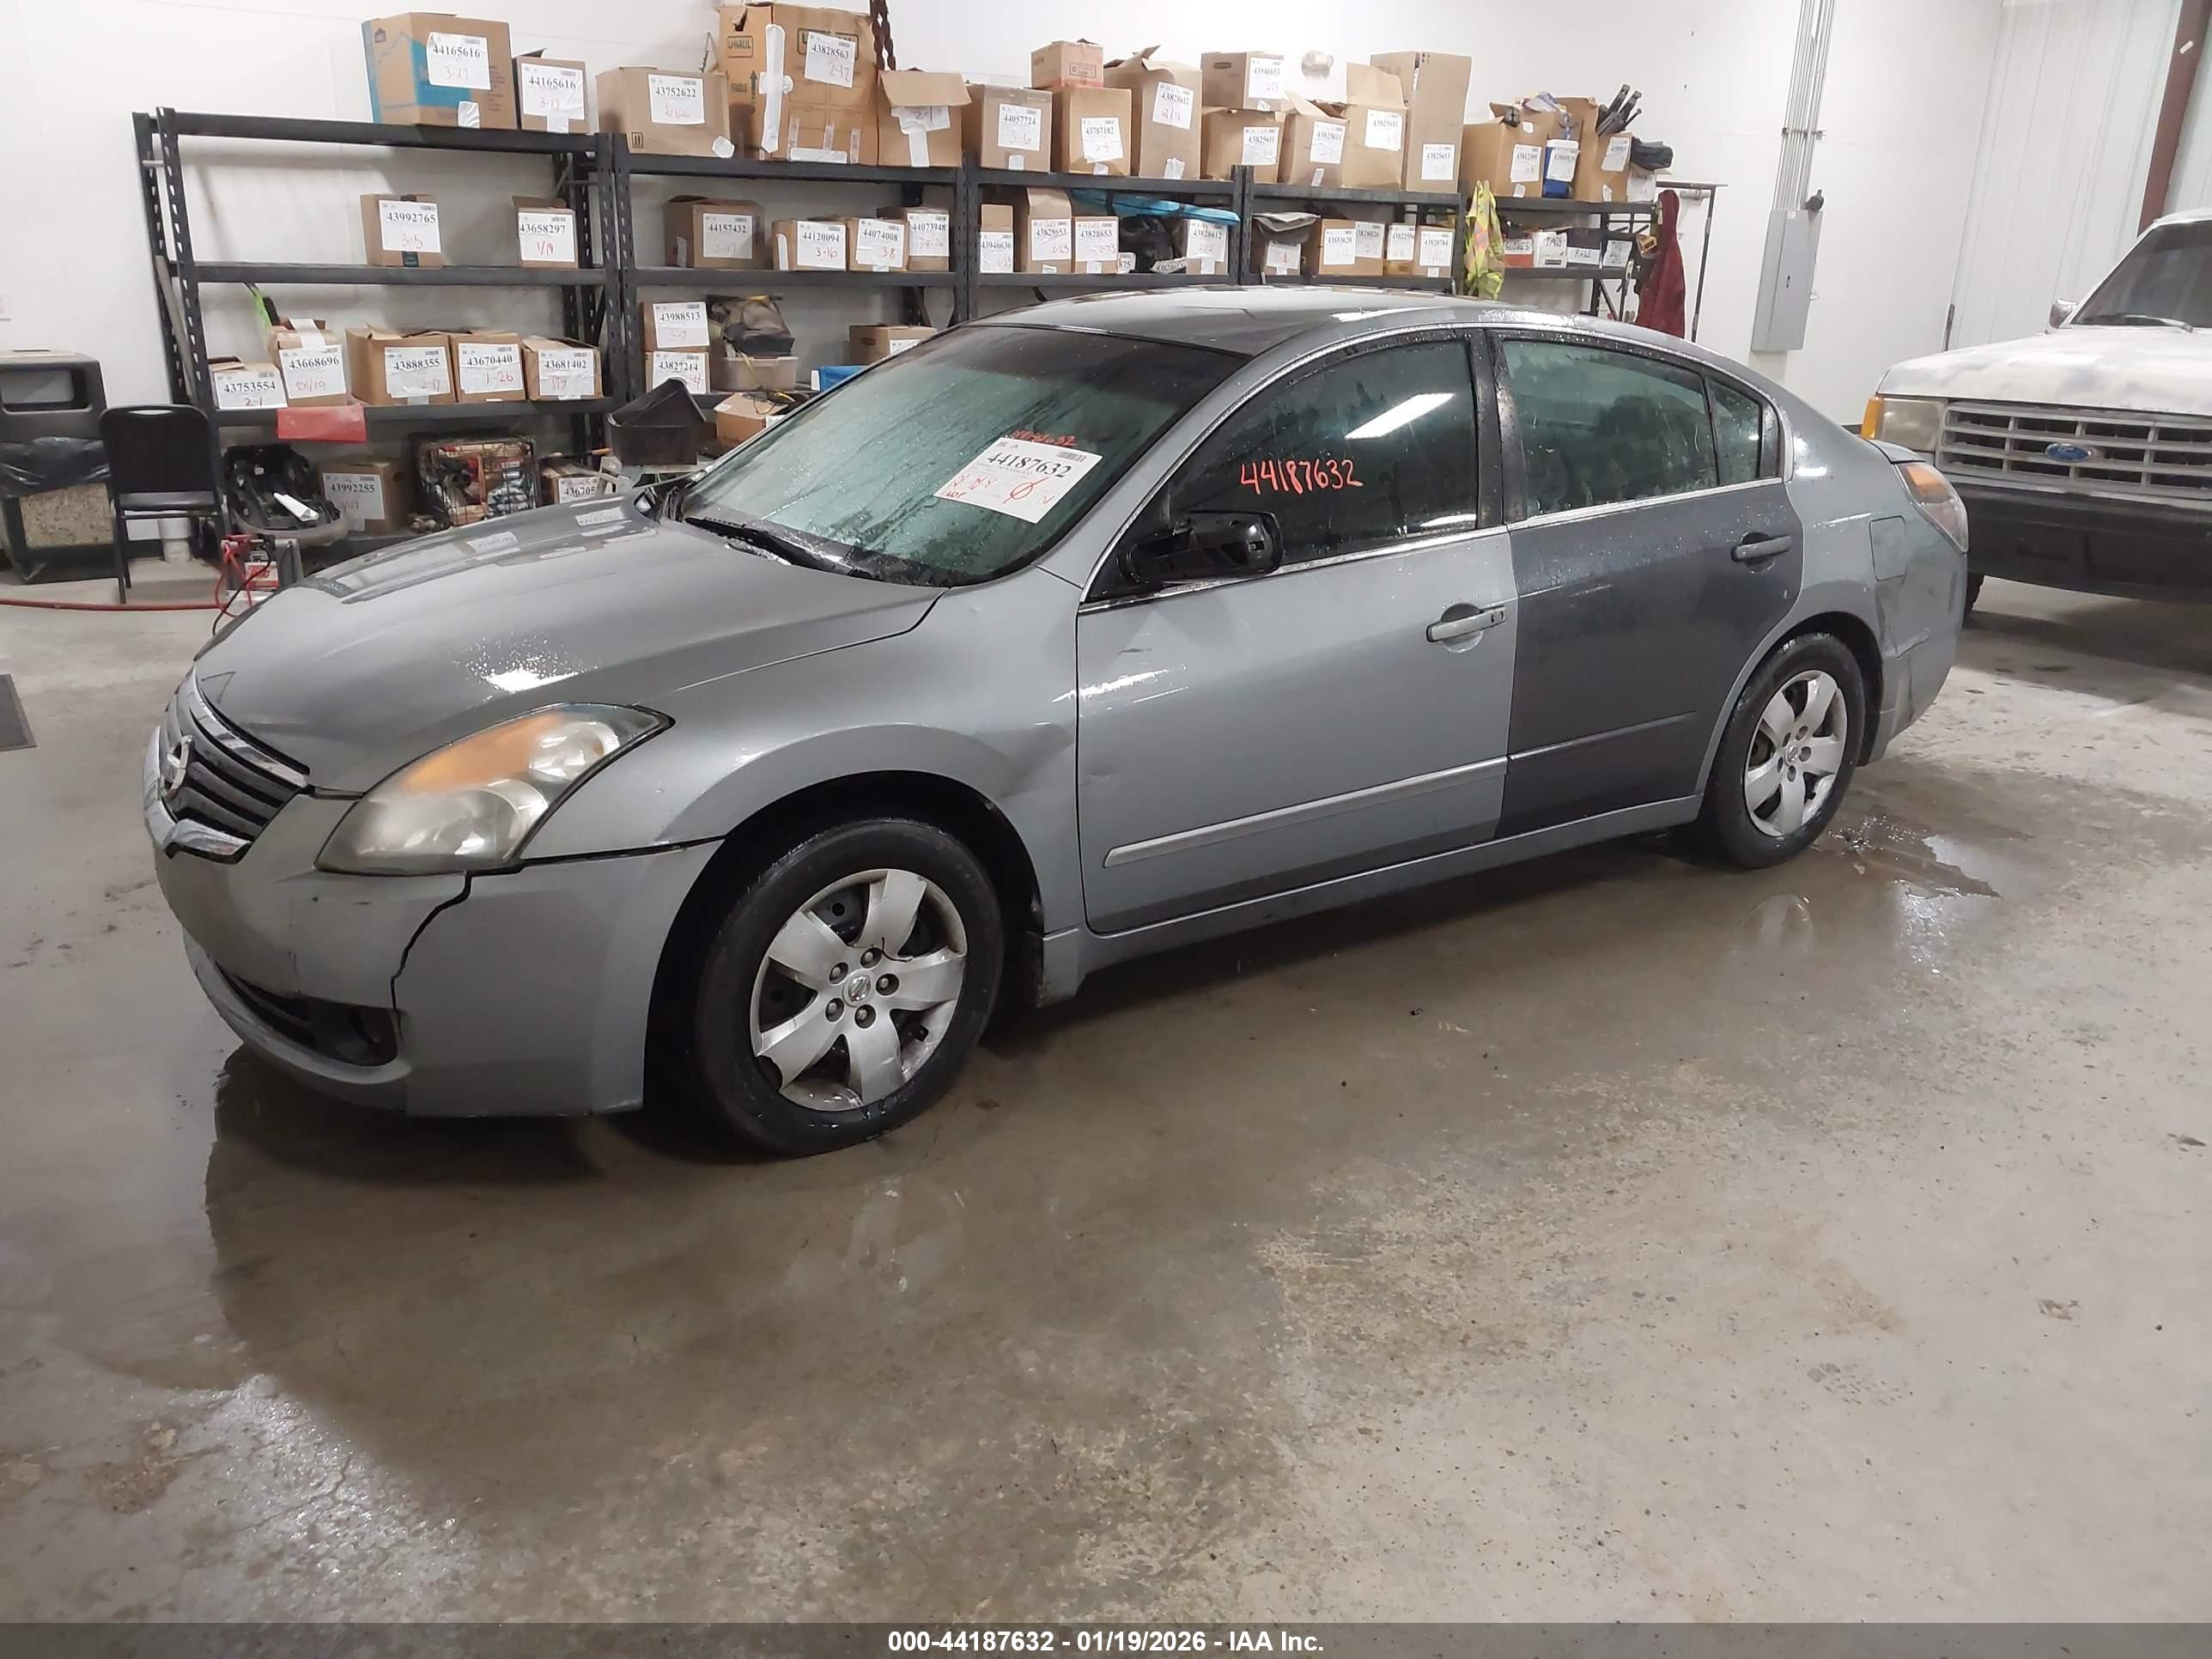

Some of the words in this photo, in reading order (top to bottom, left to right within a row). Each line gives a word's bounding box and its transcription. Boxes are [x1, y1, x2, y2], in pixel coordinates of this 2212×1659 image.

[433, 45, 481, 58] 44165616
[811, 44, 849, 59] 43828563
[529, 76, 576, 89] 44165616
[655, 87, 696, 98] 43752622
[1004, 114, 1036, 125] 44057724
[386, 211, 436, 224] 43992765
[520, 223, 566, 234] 43658297
[708, 223, 746, 234] 44157432
[912, 222, 946, 232] 44073948
[802, 232, 840, 243] 44120094
[863, 228, 899, 241] 44074008
[659, 312, 701, 322] 43988513
[289, 356, 339, 370] 43668696
[393, 358, 441, 371] 43888355
[467, 355, 513, 368] 43670440
[544, 360, 586, 369] 43681402
[659, 362, 698, 372] 43827214
[223, 380, 276, 393] 43753554
[987, 453, 1073, 478] 44187632
[1241, 459, 1364, 495] 44187632
[331, 483, 375, 493] 43992255
